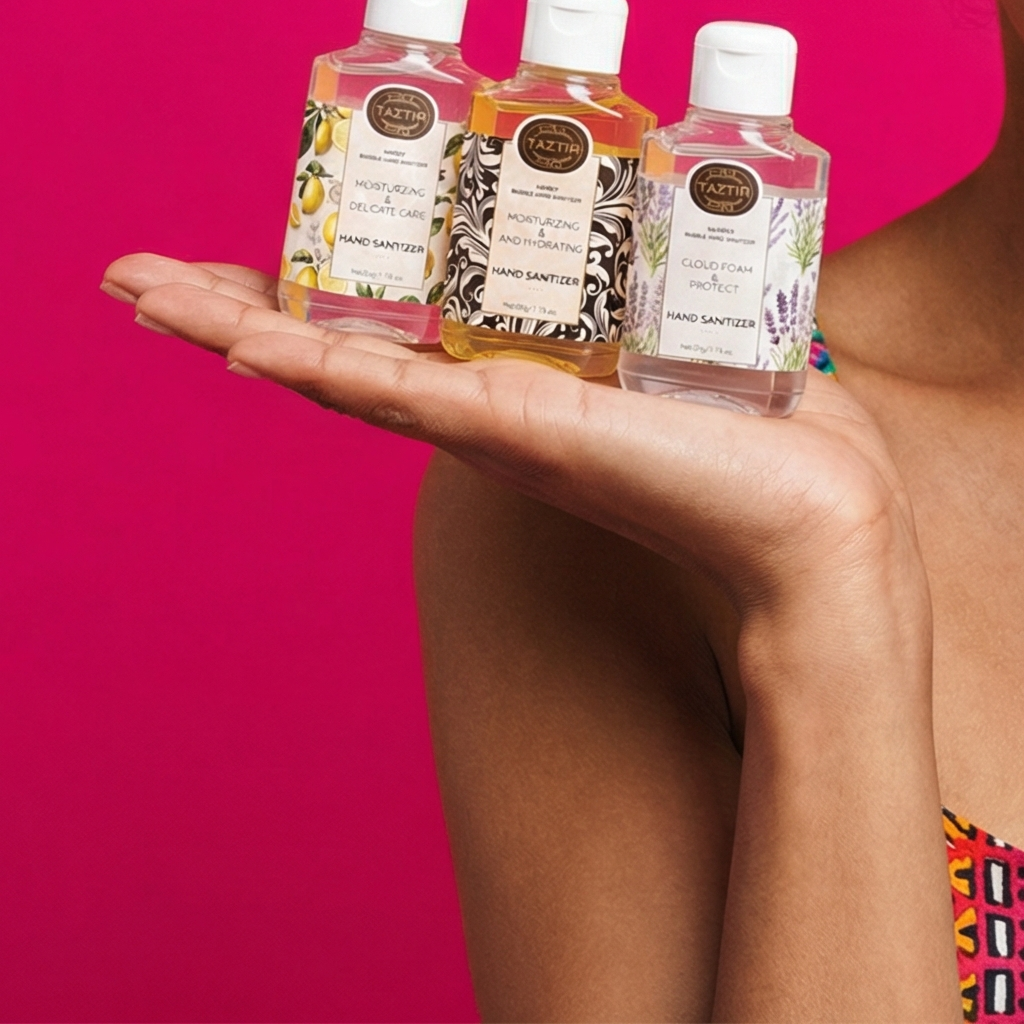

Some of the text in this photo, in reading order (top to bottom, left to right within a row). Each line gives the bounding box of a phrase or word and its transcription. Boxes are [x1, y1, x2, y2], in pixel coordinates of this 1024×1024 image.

[399, 208, 427, 221] CARE
[339, 234, 371, 247] HAND
[498, 234, 522, 246] AND
[491, 266, 524, 279] HAND
[720, 262, 753, 274] FOAM
[689, 280, 739, 294] PROTECT
[666, 310, 698, 323] HAND
